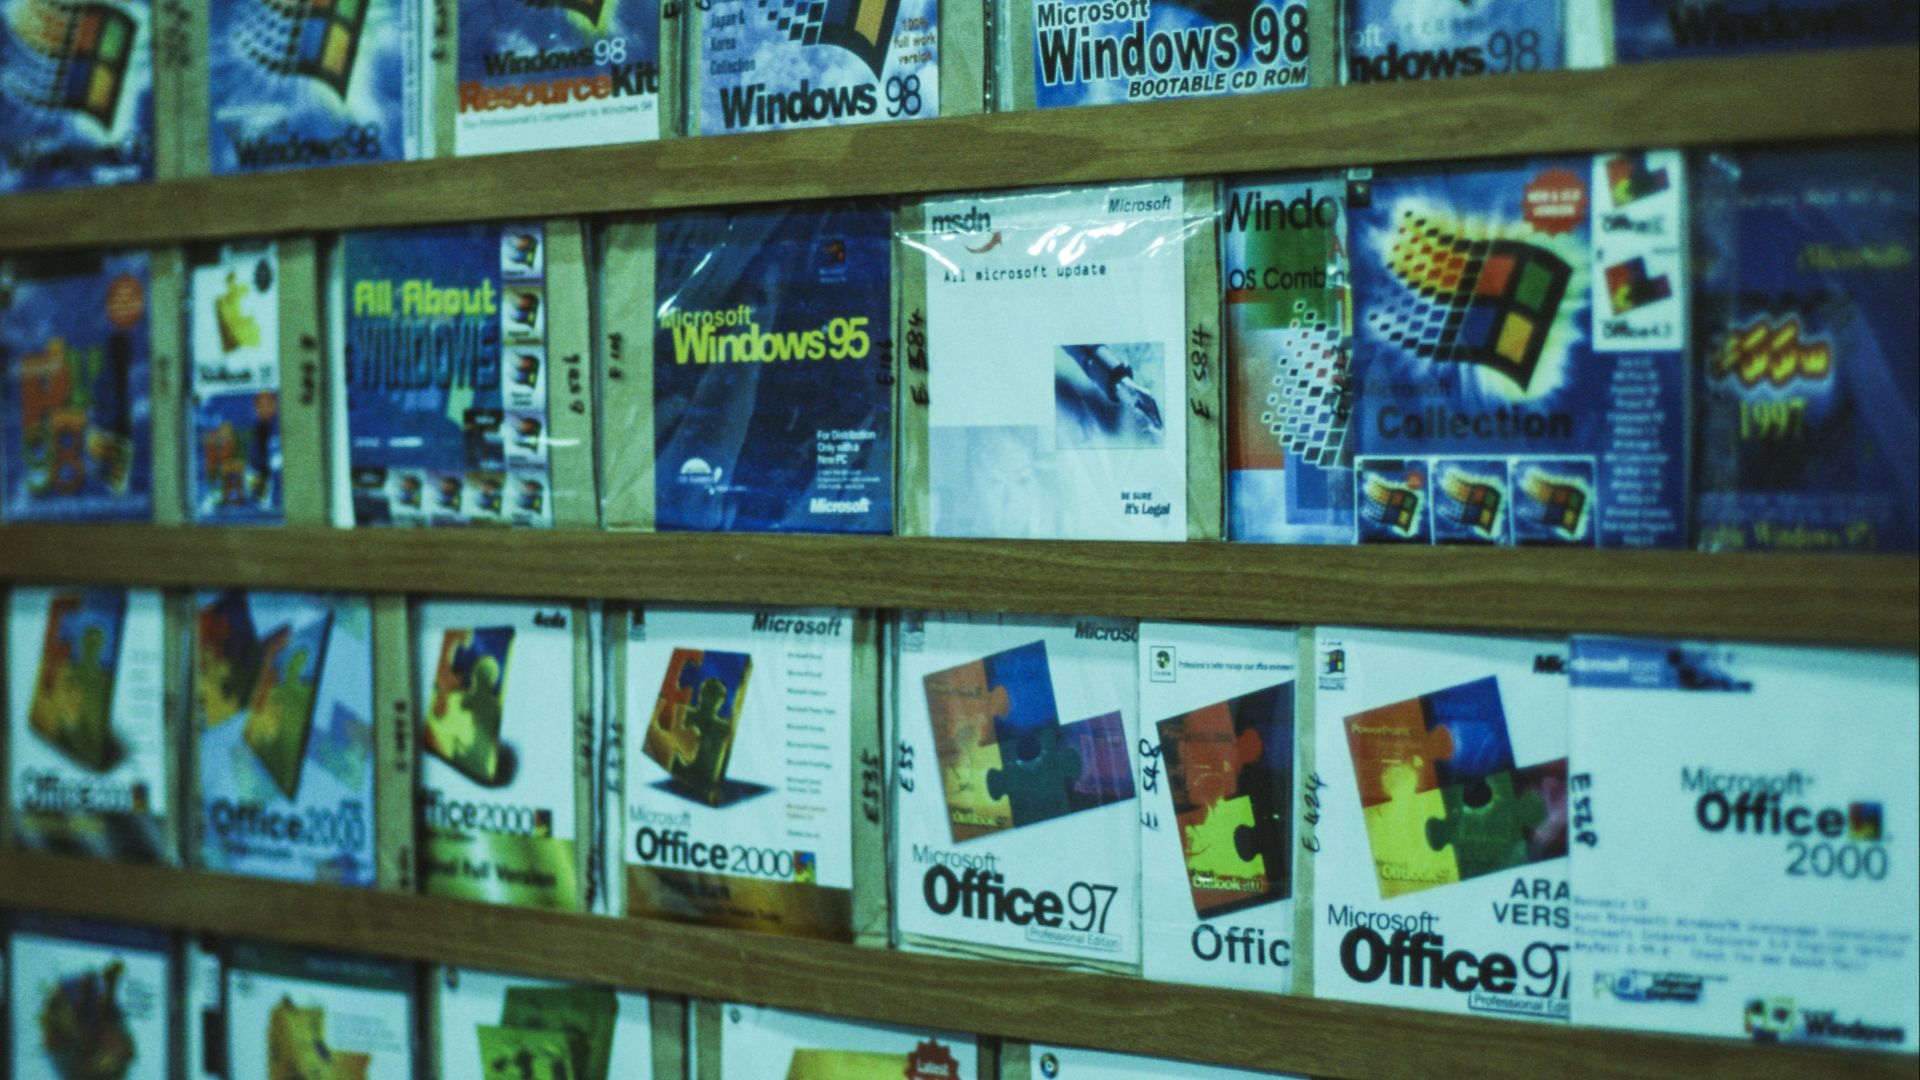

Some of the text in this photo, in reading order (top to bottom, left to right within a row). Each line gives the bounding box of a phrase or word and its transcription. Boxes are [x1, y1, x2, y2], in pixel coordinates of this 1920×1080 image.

[1037, 0, 1149, 29] Microsoft
[1038, 4, 1309, 86] Windows 98
[1128, 65, 1308, 99] BOOTABLE CD ROM
[719, 74, 922, 130] Windows 98
[1108, 195, 1172, 214] Microsoft
[931, 205, 992, 236] msdn
[943, 262, 1107, 283] All microsoft update
[353, 276, 497, 317] All About
[660, 304, 751, 329] Microsoft
[1376, 403, 1573, 441] Collection
[809, 497, 871, 514] Microsoft
[1141, 503, 1171, 518] Legal
[752, 612, 843, 637] Microsoft
[1681, 765, 1804, 797] Microsoft
[630, 804, 692, 827] Microsoft
[1695, 791, 1847, 839] Office
[635, 826, 794, 878] Office 2000
[912, 844, 999, 874] Microsoft
[1784, 841, 1889, 881] 2000
[923, 863, 1119, 935] Office 97
[1328, 903, 1435, 934] Microsoft
[1492, 903, 1570, 930] VERS
[1029, 927, 1120, 948] Professional Edition
[1191, 922, 1291, 968] Offic
[1339, 926, 1518, 995] Office
[1473, 992, 1543, 1012] Professional
